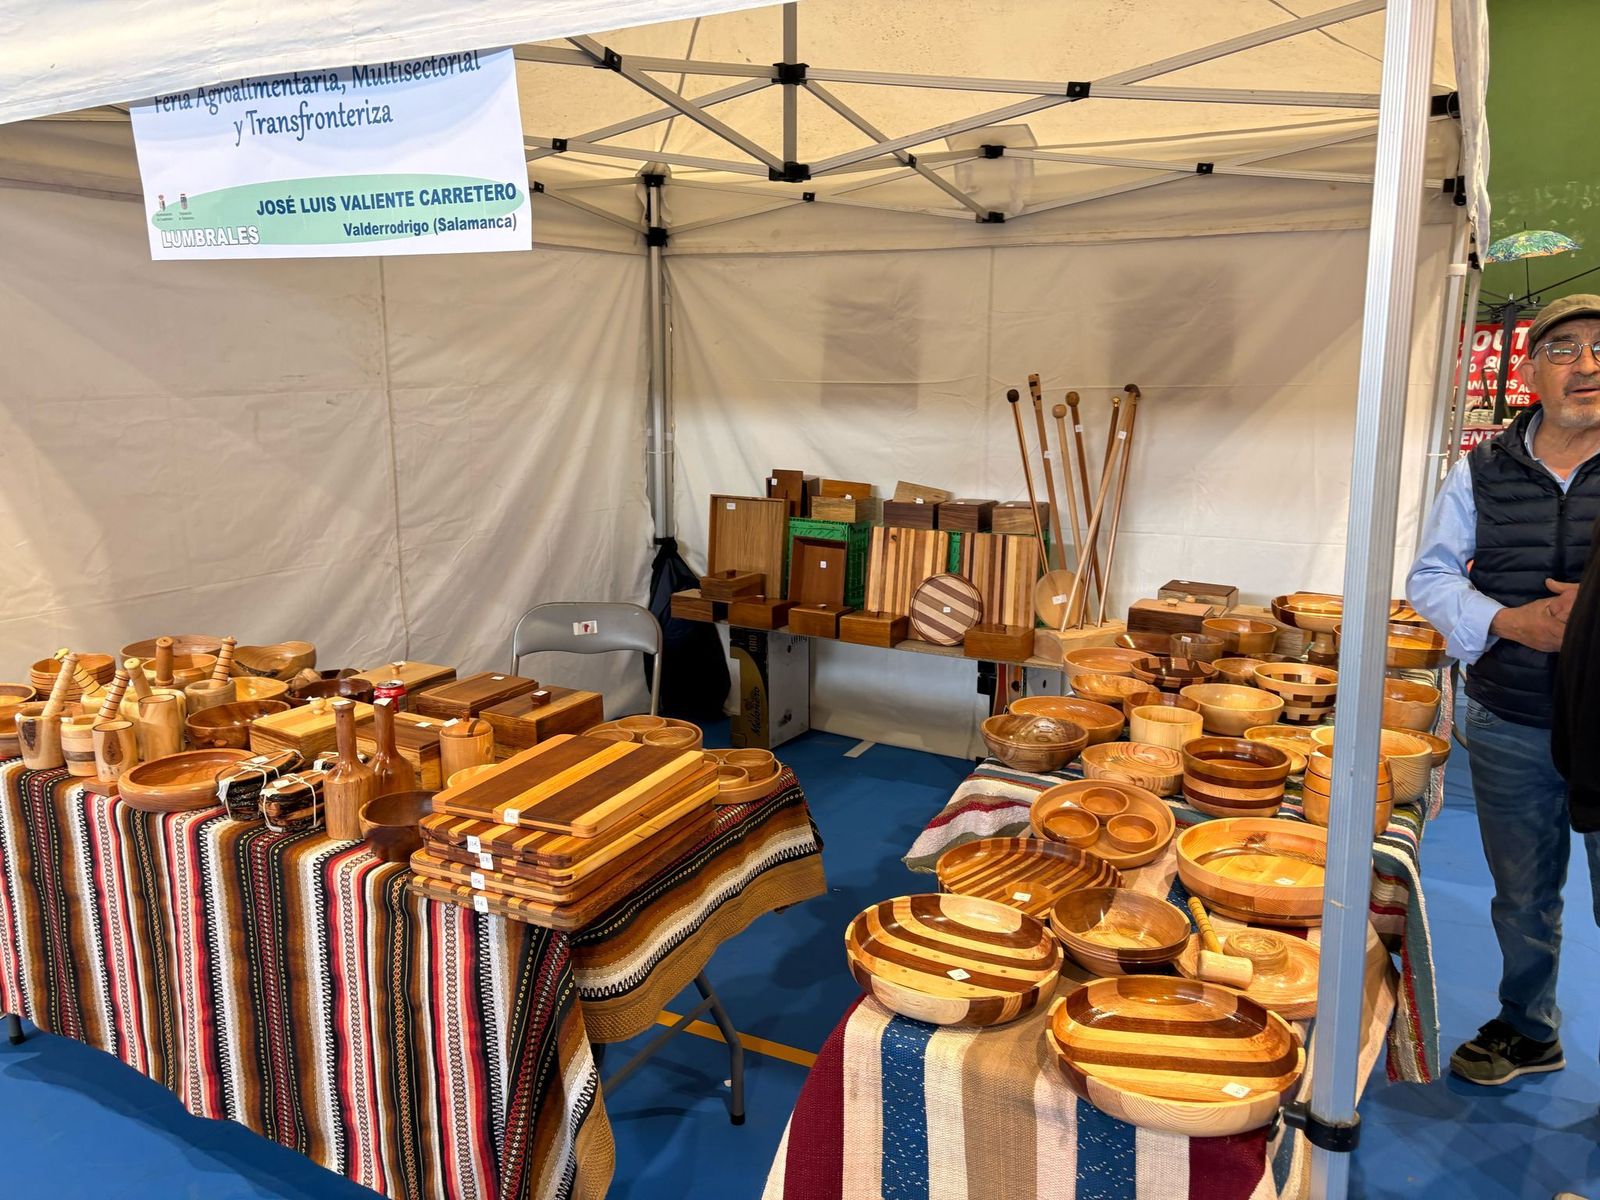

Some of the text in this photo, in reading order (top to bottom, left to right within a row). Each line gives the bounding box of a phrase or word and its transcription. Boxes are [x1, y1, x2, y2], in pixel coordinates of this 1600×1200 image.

[154, 50, 482, 115] Feria Agroalimentaria, Multisectorial
[233, 98, 394, 147] y Transfronteriza
[256, 182, 517, 216] JOSÉ LUIS VALIENTE CARRETERO
[160, 224, 261, 249] LUMBRALES
[343, 213, 517, 237] Valderrodrigo (Salamanca)
